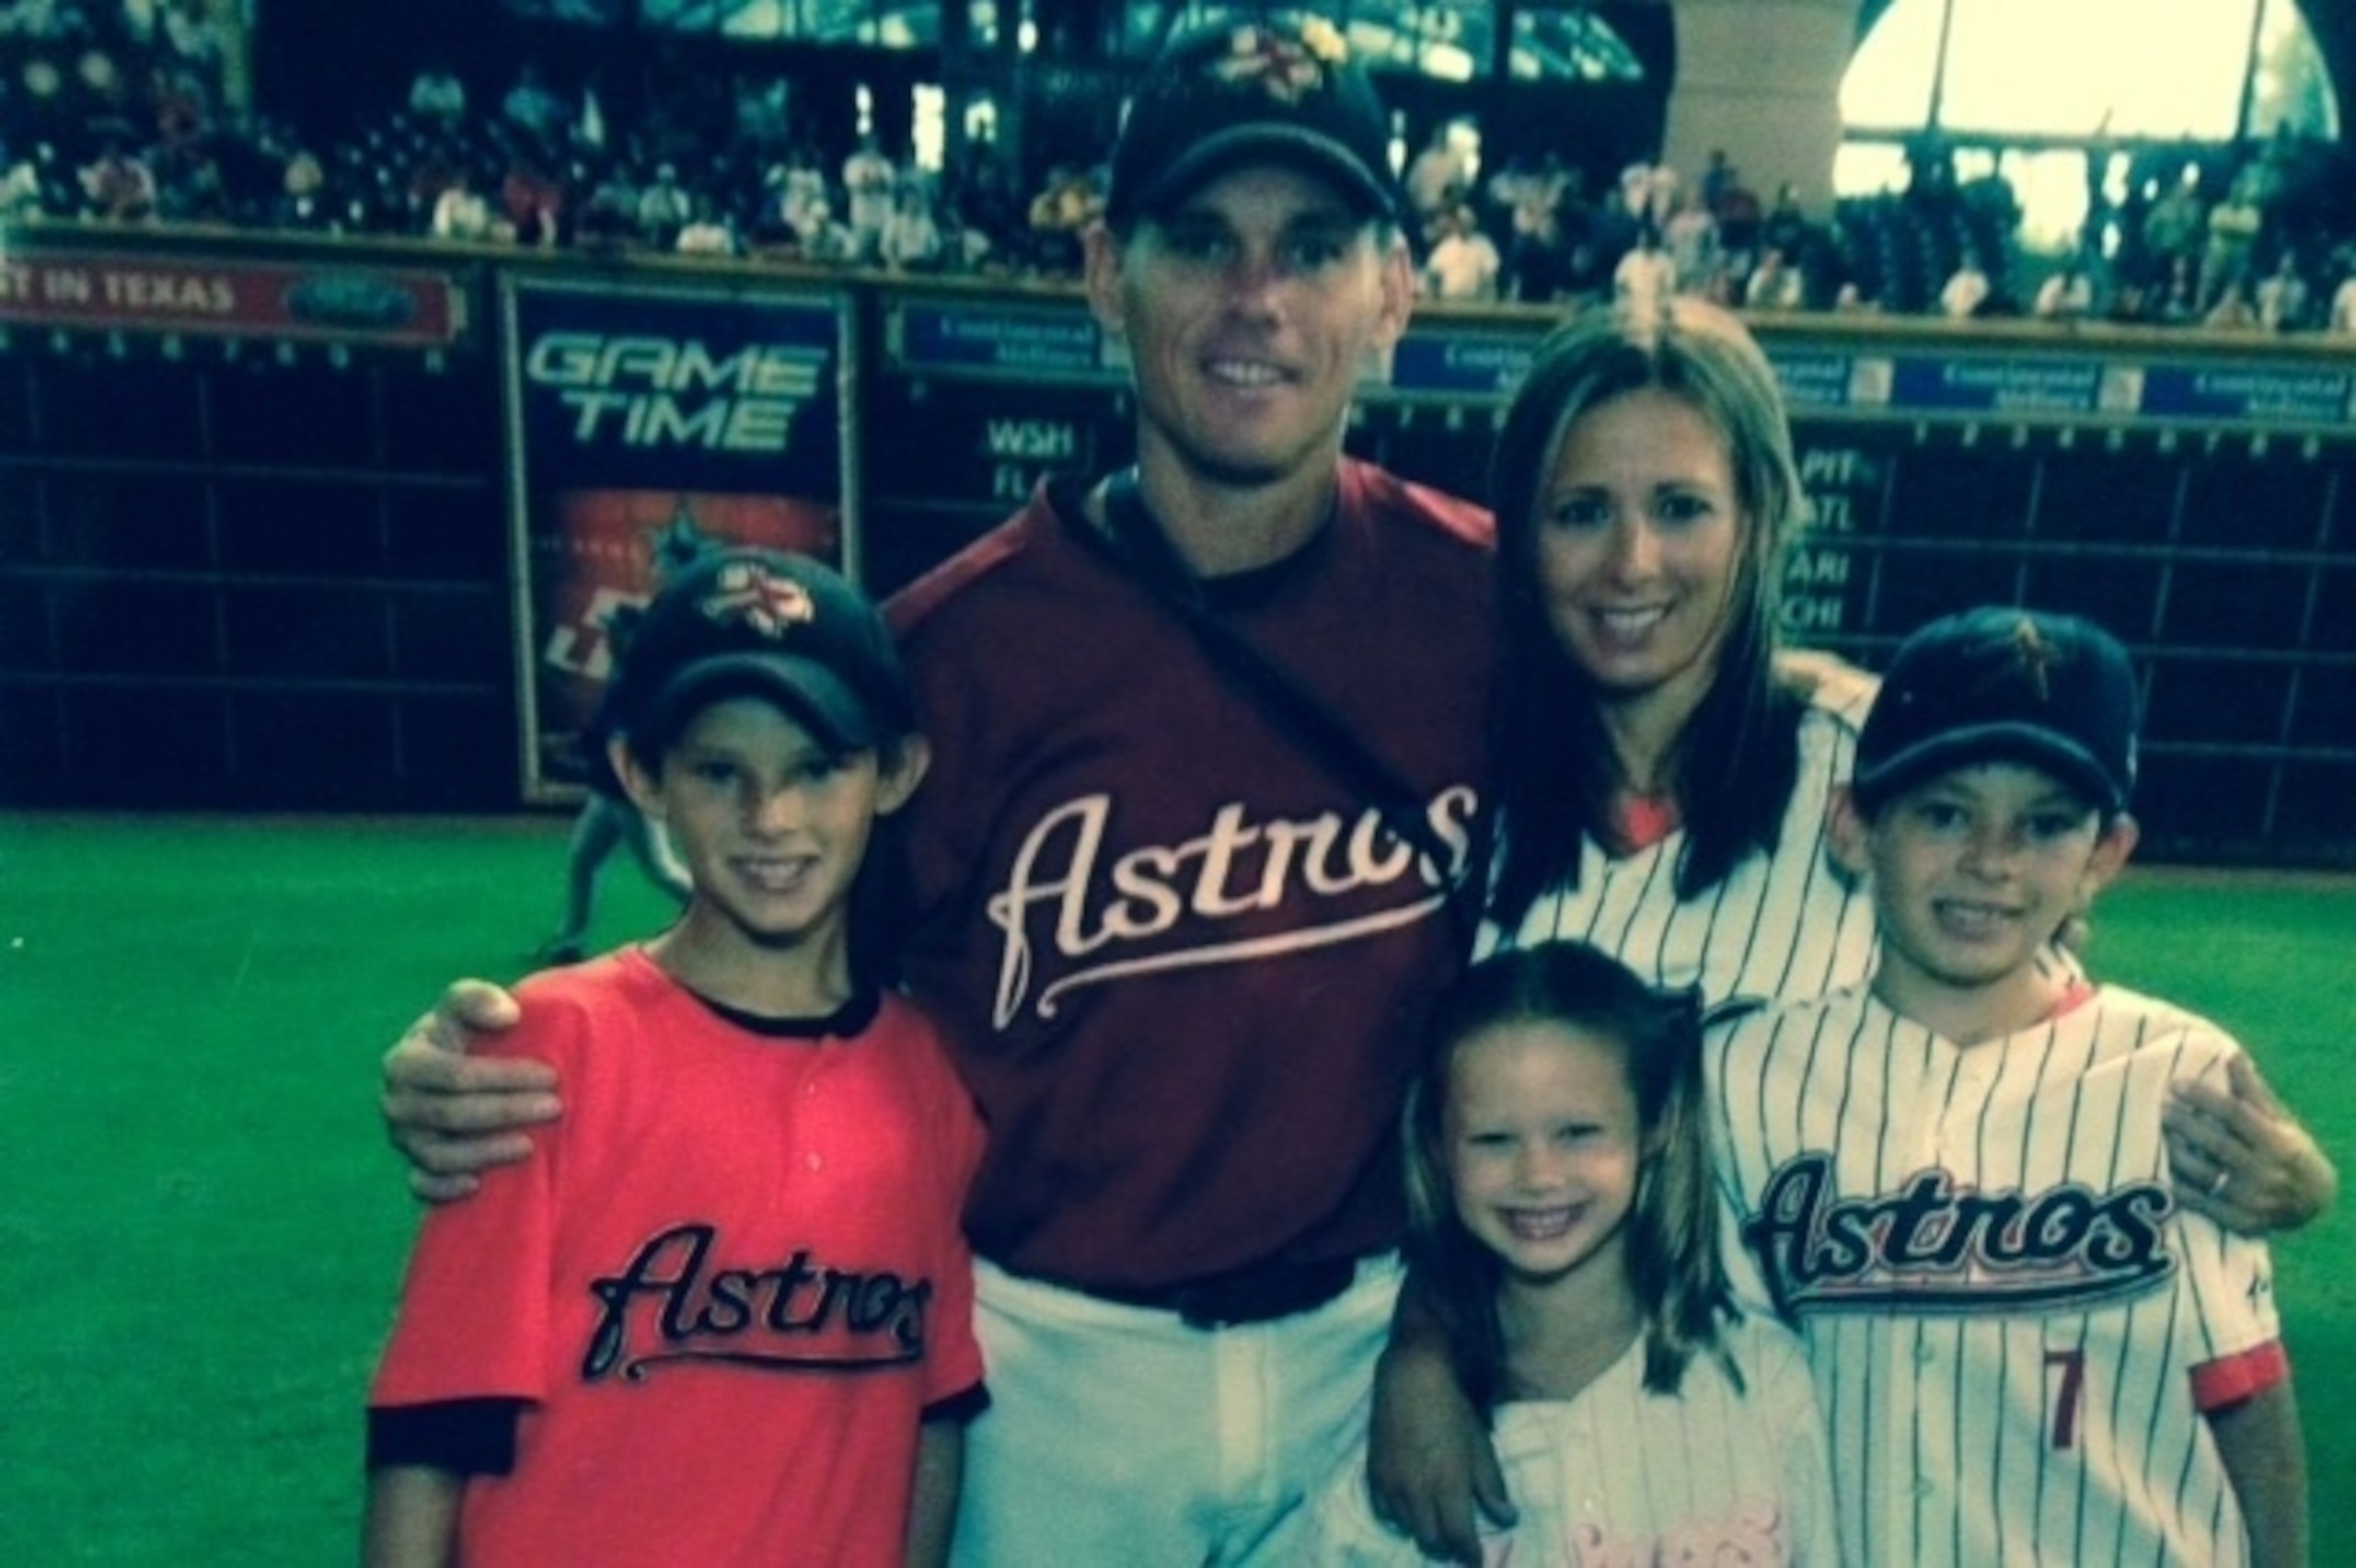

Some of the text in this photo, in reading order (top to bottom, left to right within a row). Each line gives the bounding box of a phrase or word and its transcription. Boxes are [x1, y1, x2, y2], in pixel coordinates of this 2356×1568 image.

[45, 267, 89, 304] IN
[104, 272, 234, 311] TEXAS
[526, 330, 829, 398] GAME
[560, 390, 798, 452] TIME
[987, 420, 1075, 458] WSH
[1802, 448, 1856, 485] PIT
[1787, 552, 1849, 584] ARI
[1780, 596, 1842, 628] CHI
[1743, 1150, 2177, 1332] Astros
[2044, 1349, 2085, 1451] 7
